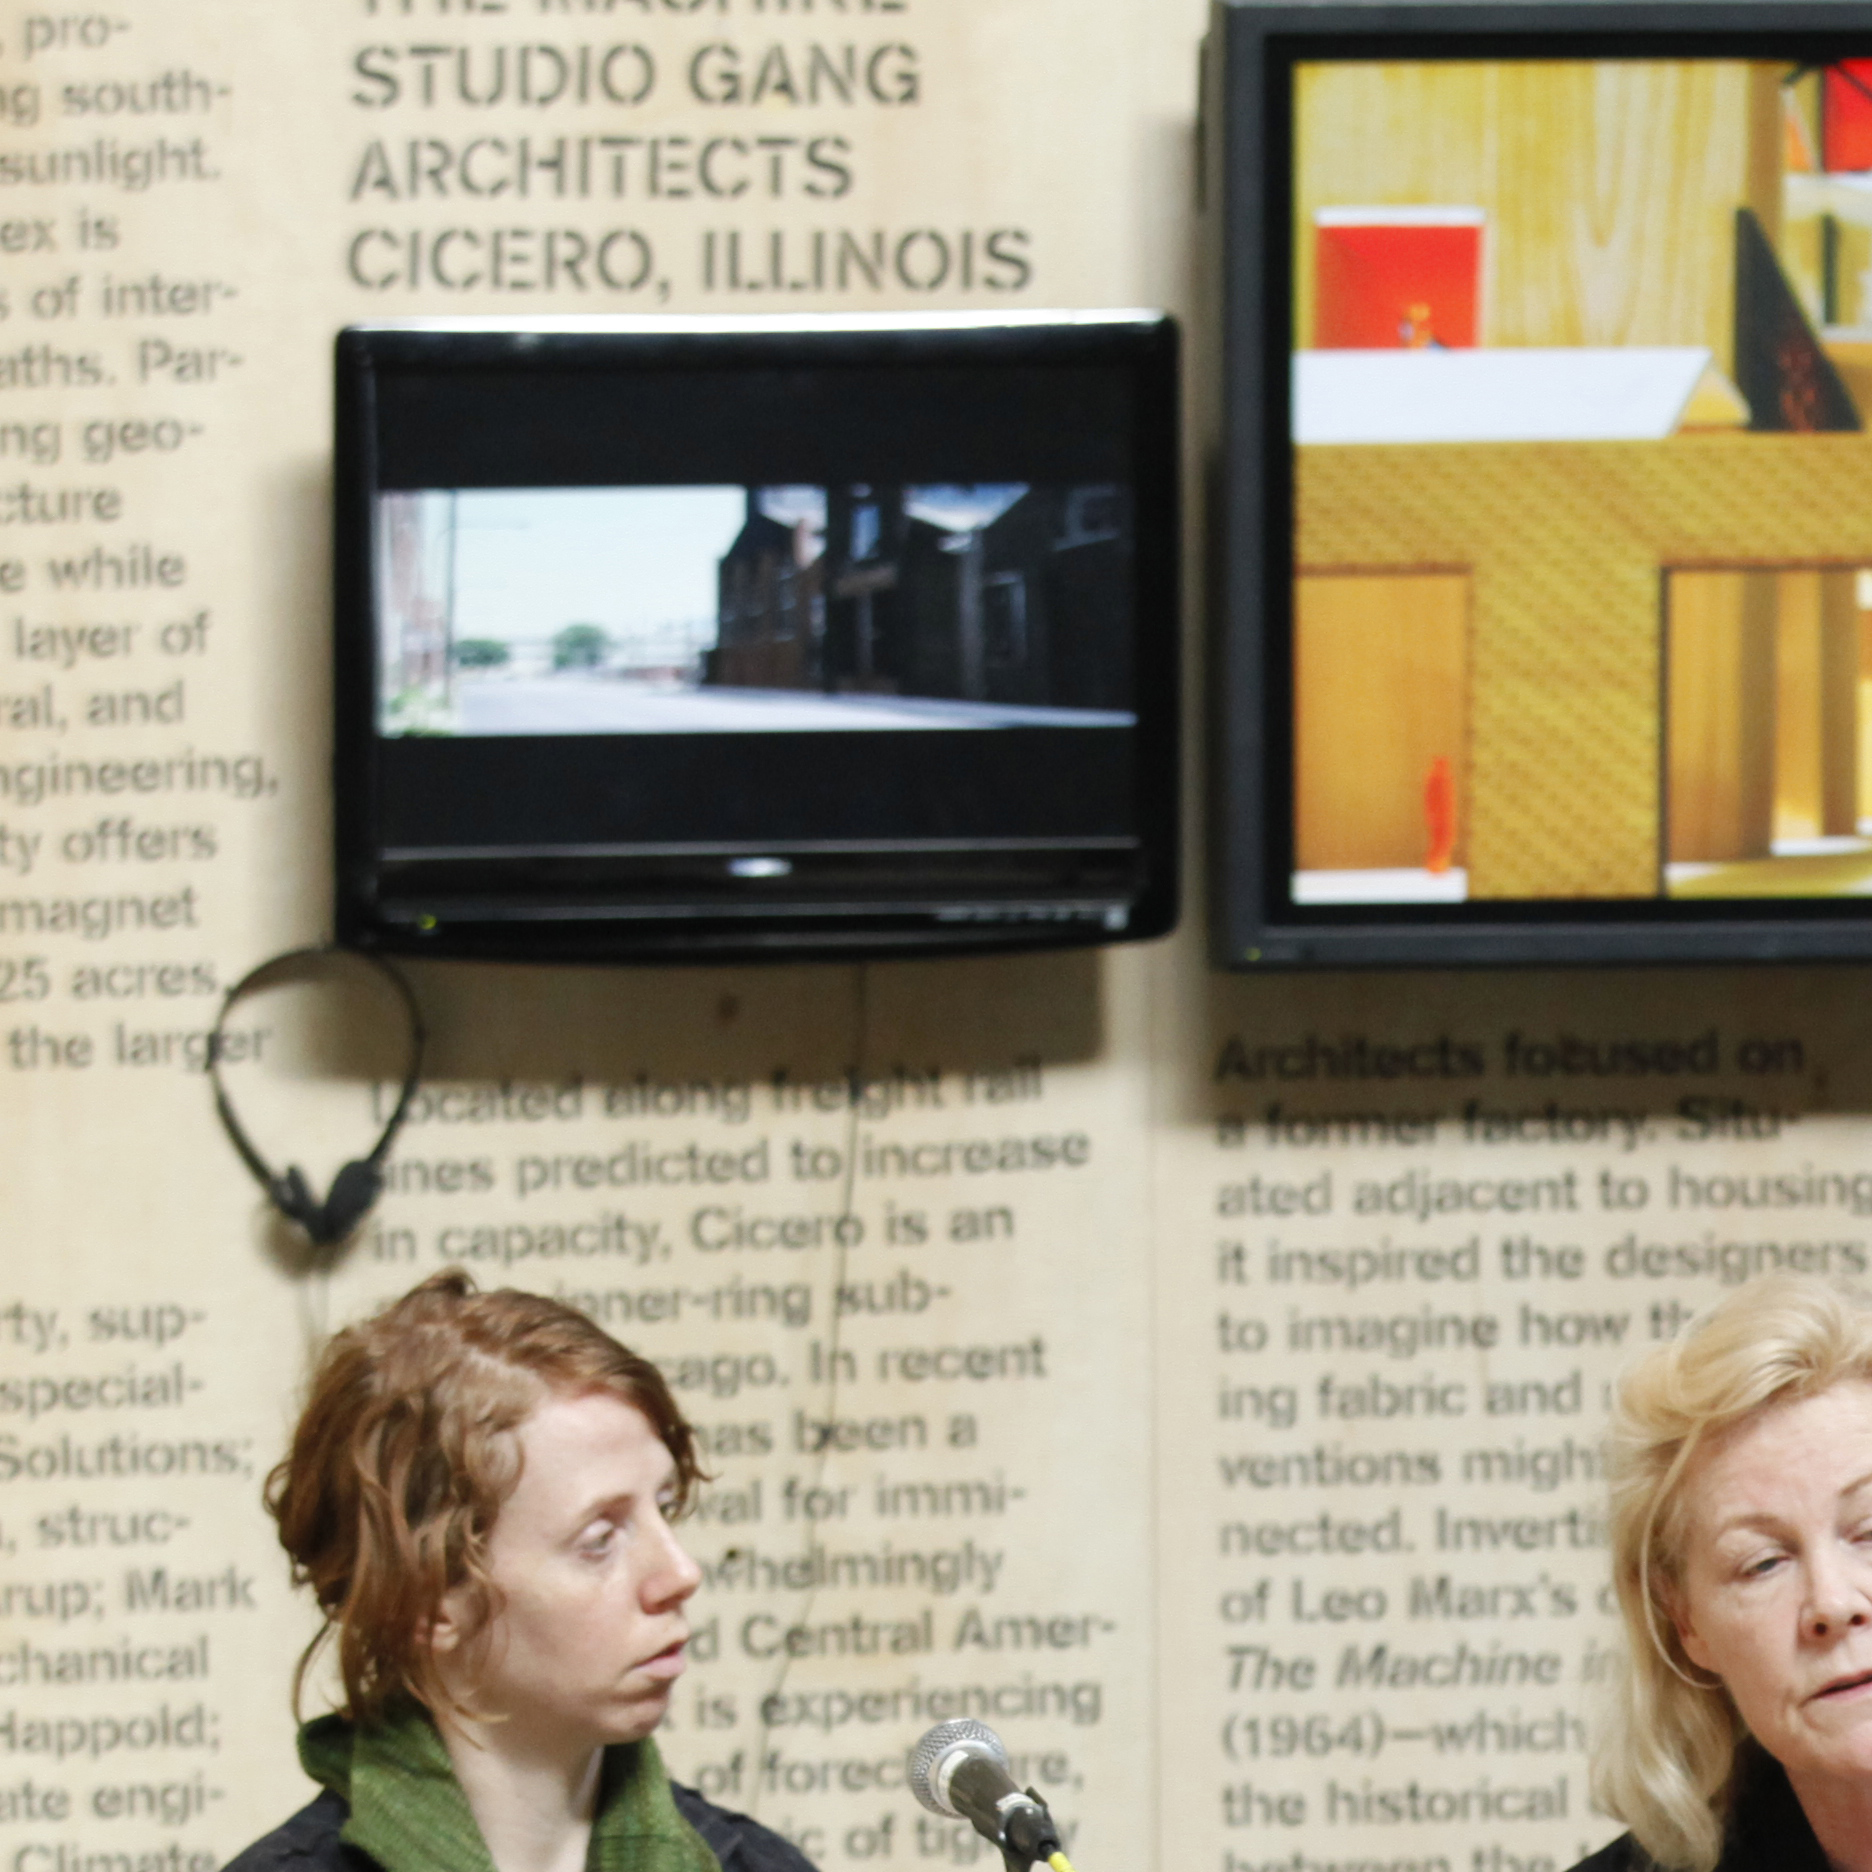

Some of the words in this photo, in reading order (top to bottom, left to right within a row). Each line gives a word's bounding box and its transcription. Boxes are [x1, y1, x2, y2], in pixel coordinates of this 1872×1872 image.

[16, 12, 128, 62] pro-
[58, 70, 231, 116] south-
[351, 43, 657, 107] STUDIO
[685, 43, 922, 107] GANG
[349, 133, 855, 201] ARCHITECTS
[345, 228, 671, 295] CICERO,
[701, 228, 1034, 294] ILLINOIS
[27, 273, 82, 321] of
[100, 272, 235, 317] inter-
[134, 336, 242, 383] Par-
[79, 418, 201, 464] geo-
[44, 544, 186, 589] while
[12, 615, 134, 671] layer
[158, 609, 210, 655] of
[59, 816, 218, 862] offers
[515, 1135, 771, 1196] predicted
[789, 1139, 840, 1181] to
[861, 1131, 1090, 1176] increase
[1216, 1172, 1333, 1218] ated
[1595, 1167, 1651, 1212] to
[374, 1217, 417, 1260] in
[436, 1212, 670, 1272] capacity,
[691, 1204, 866, 1252] Cicero
[883, 1199, 930, 1246] is
[947, 1205, 1015, 1244] an
[1217, 1241, 1247, 1285] it
[1267, 1237, 1481, 1289] inspired
[1498, 1234, 1586, 1282] the
[1602, 1231, 1870, 1288] designers
[86, 1304, 204, 1347] sup-
[1216, 1311, 1269, 1353] to
[1287, 1306, 1500, 1362] imagine
[1518, 1301, 1632, 1349] how
[810, 1339, 858, 1382] In
[876, 1338, 1047, 1385] recent
[34, 1505, 190, 1548] struc-
[1219, 1508, 1415, 1558] nected.
[123, 1566, 255, 1613] Mark
[754, 1611, 935, 1659] Central
[951, 1604, 1114, 1653] Amer-
[1225, 1642, 1317, 1693] The
[1334, 1638, 1563, 1691] Machine
[693, 1685, 739, 1730] is
[762, 1678, 1103, 1740] experiencing
[89, 1774, 224, 1826] engi-
[1220, 1782, 1307, 1829] the
[1325, 1776, 1570, 1826] historical
